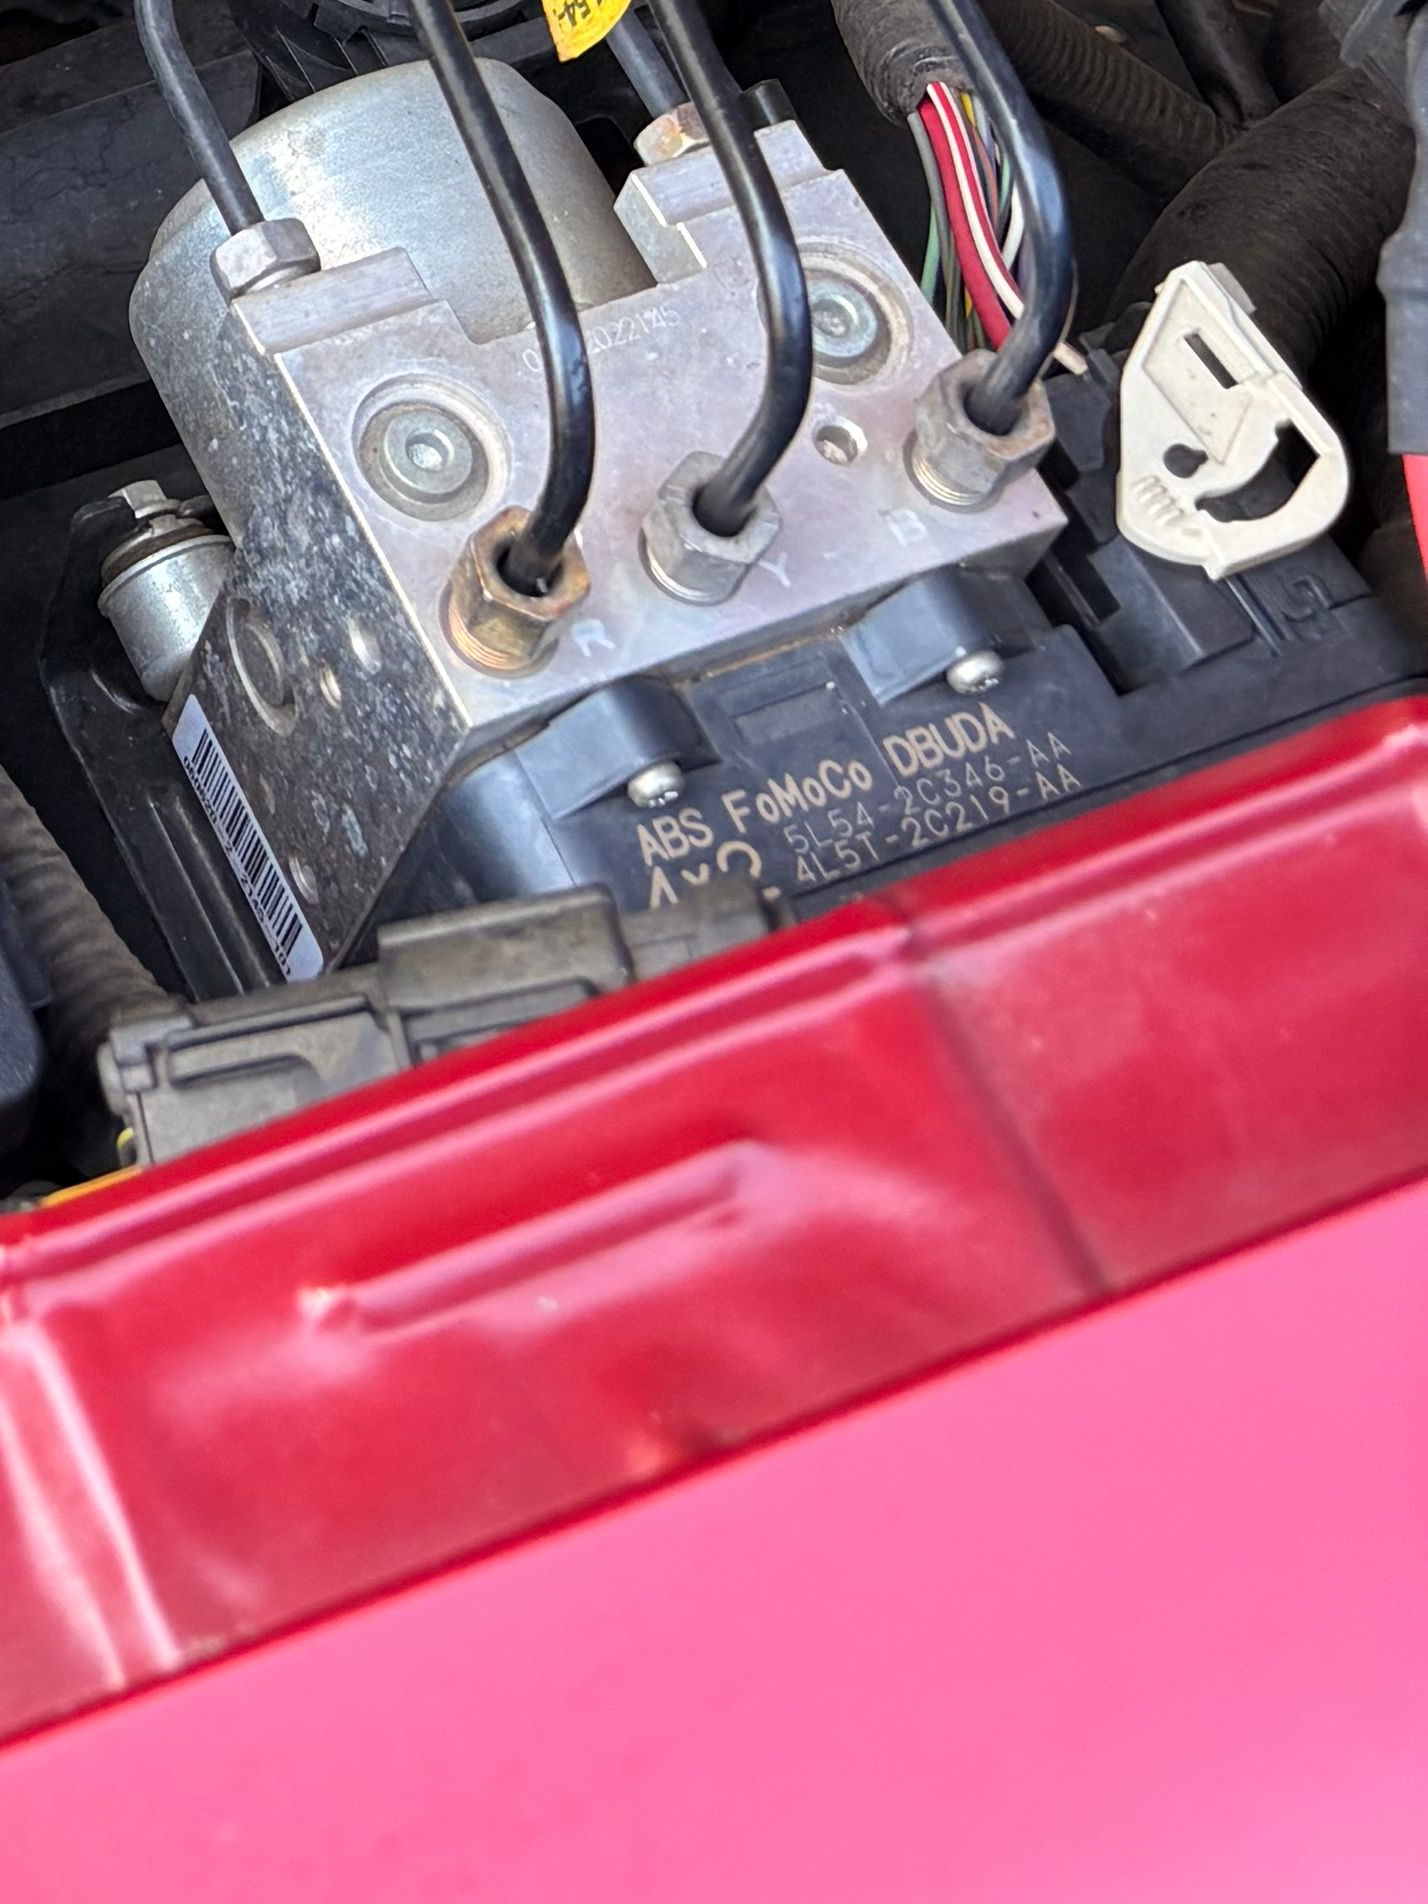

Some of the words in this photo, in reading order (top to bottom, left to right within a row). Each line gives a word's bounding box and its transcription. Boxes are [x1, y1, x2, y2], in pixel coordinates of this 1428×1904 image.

[637, 808, 715, 867] ABS
[723, 758, 873, 833] FoMoCo
[882, 701, 1016, 779] DBUDA
[782, 731, 1072, 854] 5L54-2C346-AA
[794, 763, 1083, 884] 4L5T-2C219-AA
